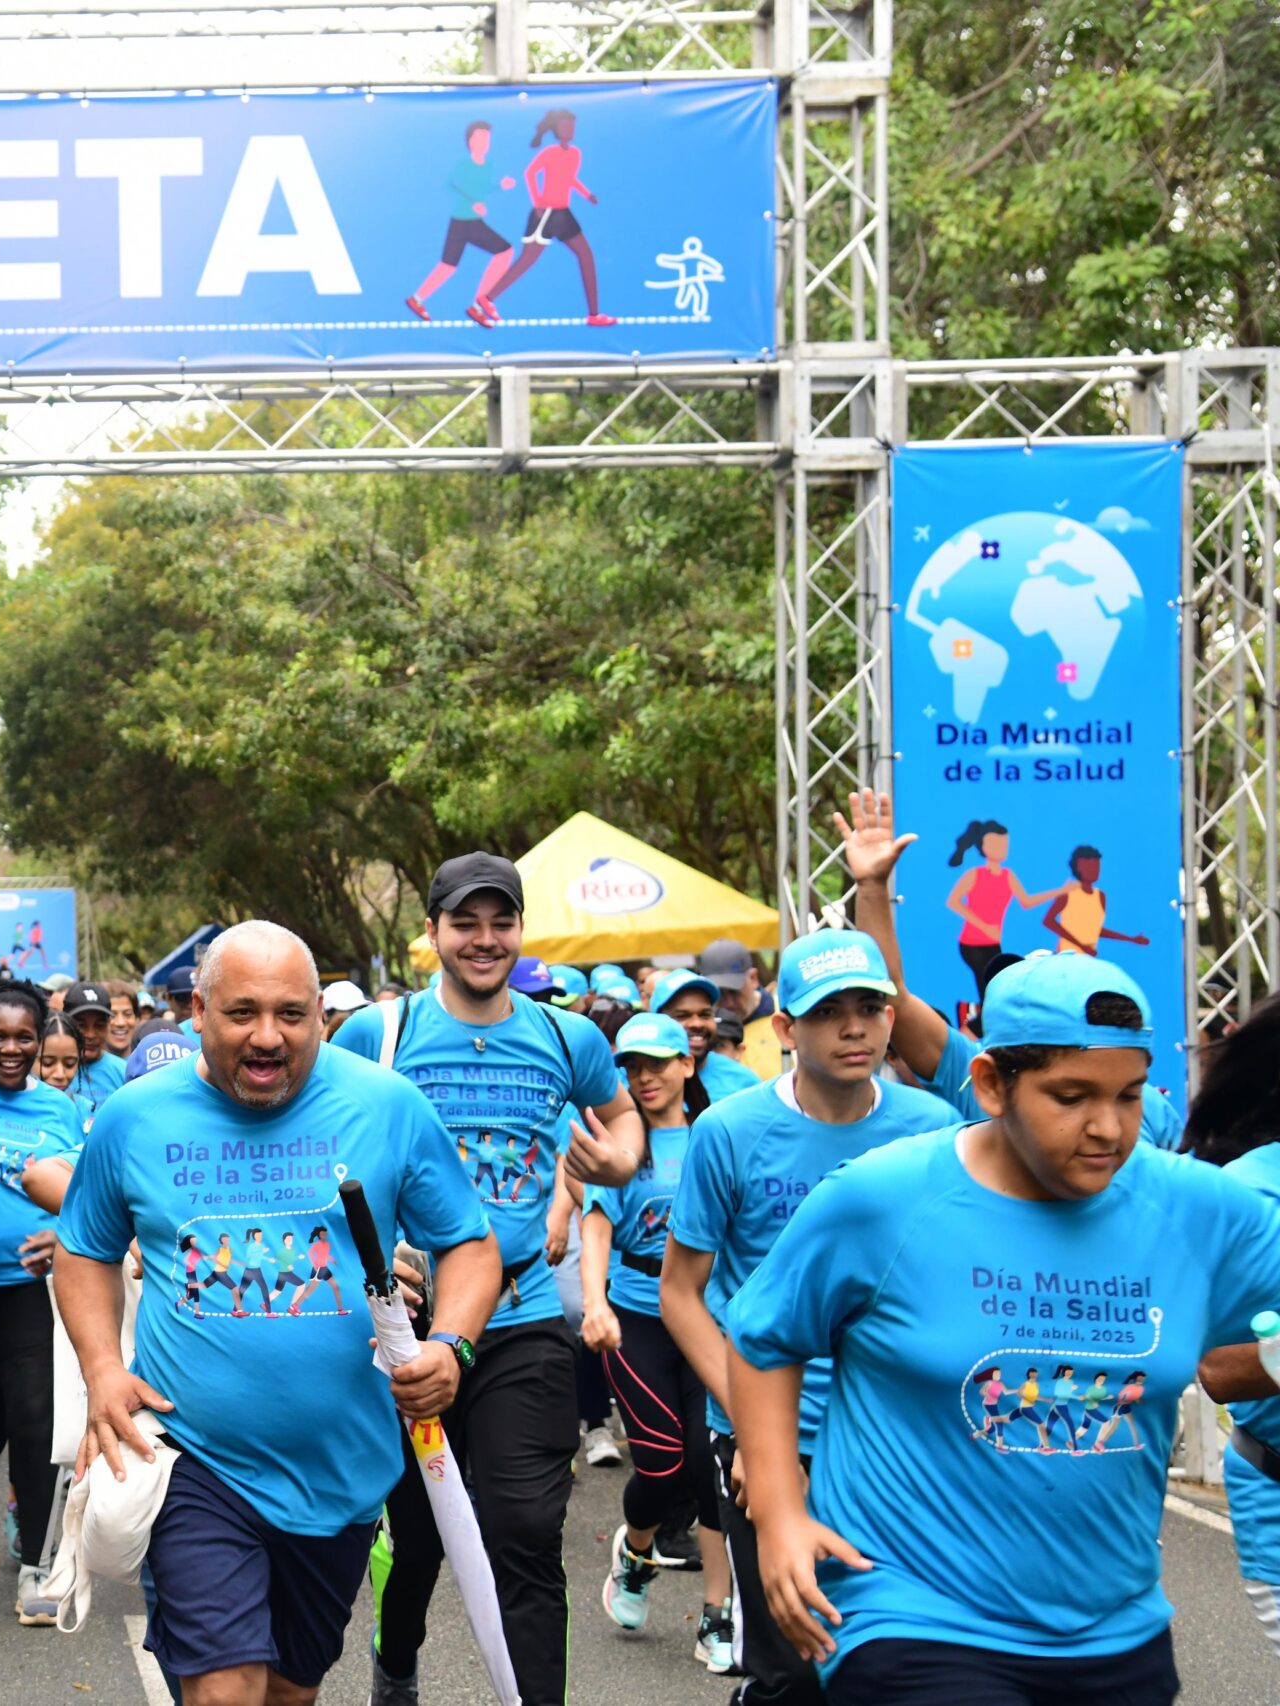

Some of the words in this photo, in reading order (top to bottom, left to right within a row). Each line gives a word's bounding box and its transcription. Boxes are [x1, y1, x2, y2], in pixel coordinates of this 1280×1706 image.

[936, 721, 988, 745] Día
[1001, 720, 1133, 744] Mundial
[944, 760, 982, 781] de
[995, 760, 1021, 781] la
[1034, 758, 1125, 781] Salud
[581, 882, 648, 900] Rica
[415, 1066, 453, 1083] Día
[462, 1066, 553, 1086] Mundial
[423, 1084, 449, 1100] de
[459, 1084, 477, 1100] la
[488, 1084, 548, 1106] Salud
[447, 1106, 462, 1116] de
[505, 1107, 537, 1118] 2025
[166, 1140, 209, 1163] Día
[222, 1135, 338, 1161] Mundial
[173, 1166, 205, 1187] de
[216, 1165, 239, 1185] la
[251, 1160, 331, 1183] Salud
[189, 1193, 198, 1205] 7
[203, 1192, 223, 1205] de
[229, 1190, 269, 1204] abril,
[273, 1187, 316, 1201] 2025
[764, 1175, 809, 1197] Día
[972, 1267, 1022, 1291] Día
[1035, 1271, 1151, 1298] Mundial
[981, 1294, 1017, 1316] de
[1029, 1296, 1054, 1318] la
[1067, 1299, 1146, 1323] Salud
[1001, 1325, 1009, 1336] 7
[1016, 1325, 1035, 1338] de
[1042, 1327, 1085, 1341] abril,
[1091, 1330, 1135, 1343] 2025
